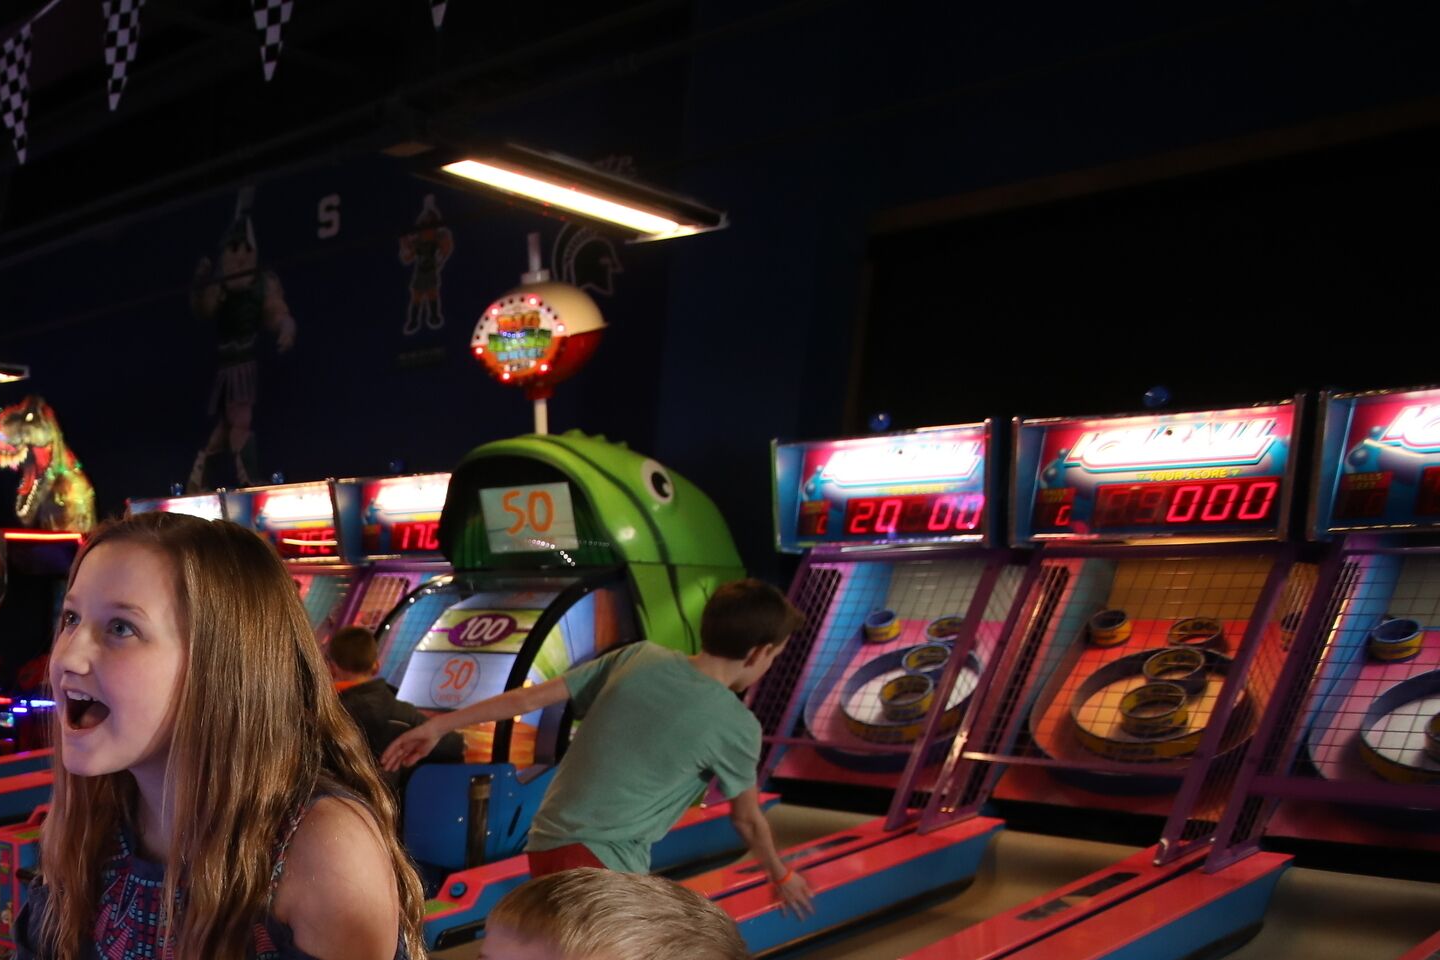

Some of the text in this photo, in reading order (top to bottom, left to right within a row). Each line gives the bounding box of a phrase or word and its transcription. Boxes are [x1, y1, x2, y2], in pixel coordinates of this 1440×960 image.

[317, 194, 340, 239] S
[1150, 468, 1228, 482] YOUR SCORE
[501, 489, 555, 535] 50
[459, 617, 510, 641] 100
[437, 659, 477, 690] 50
